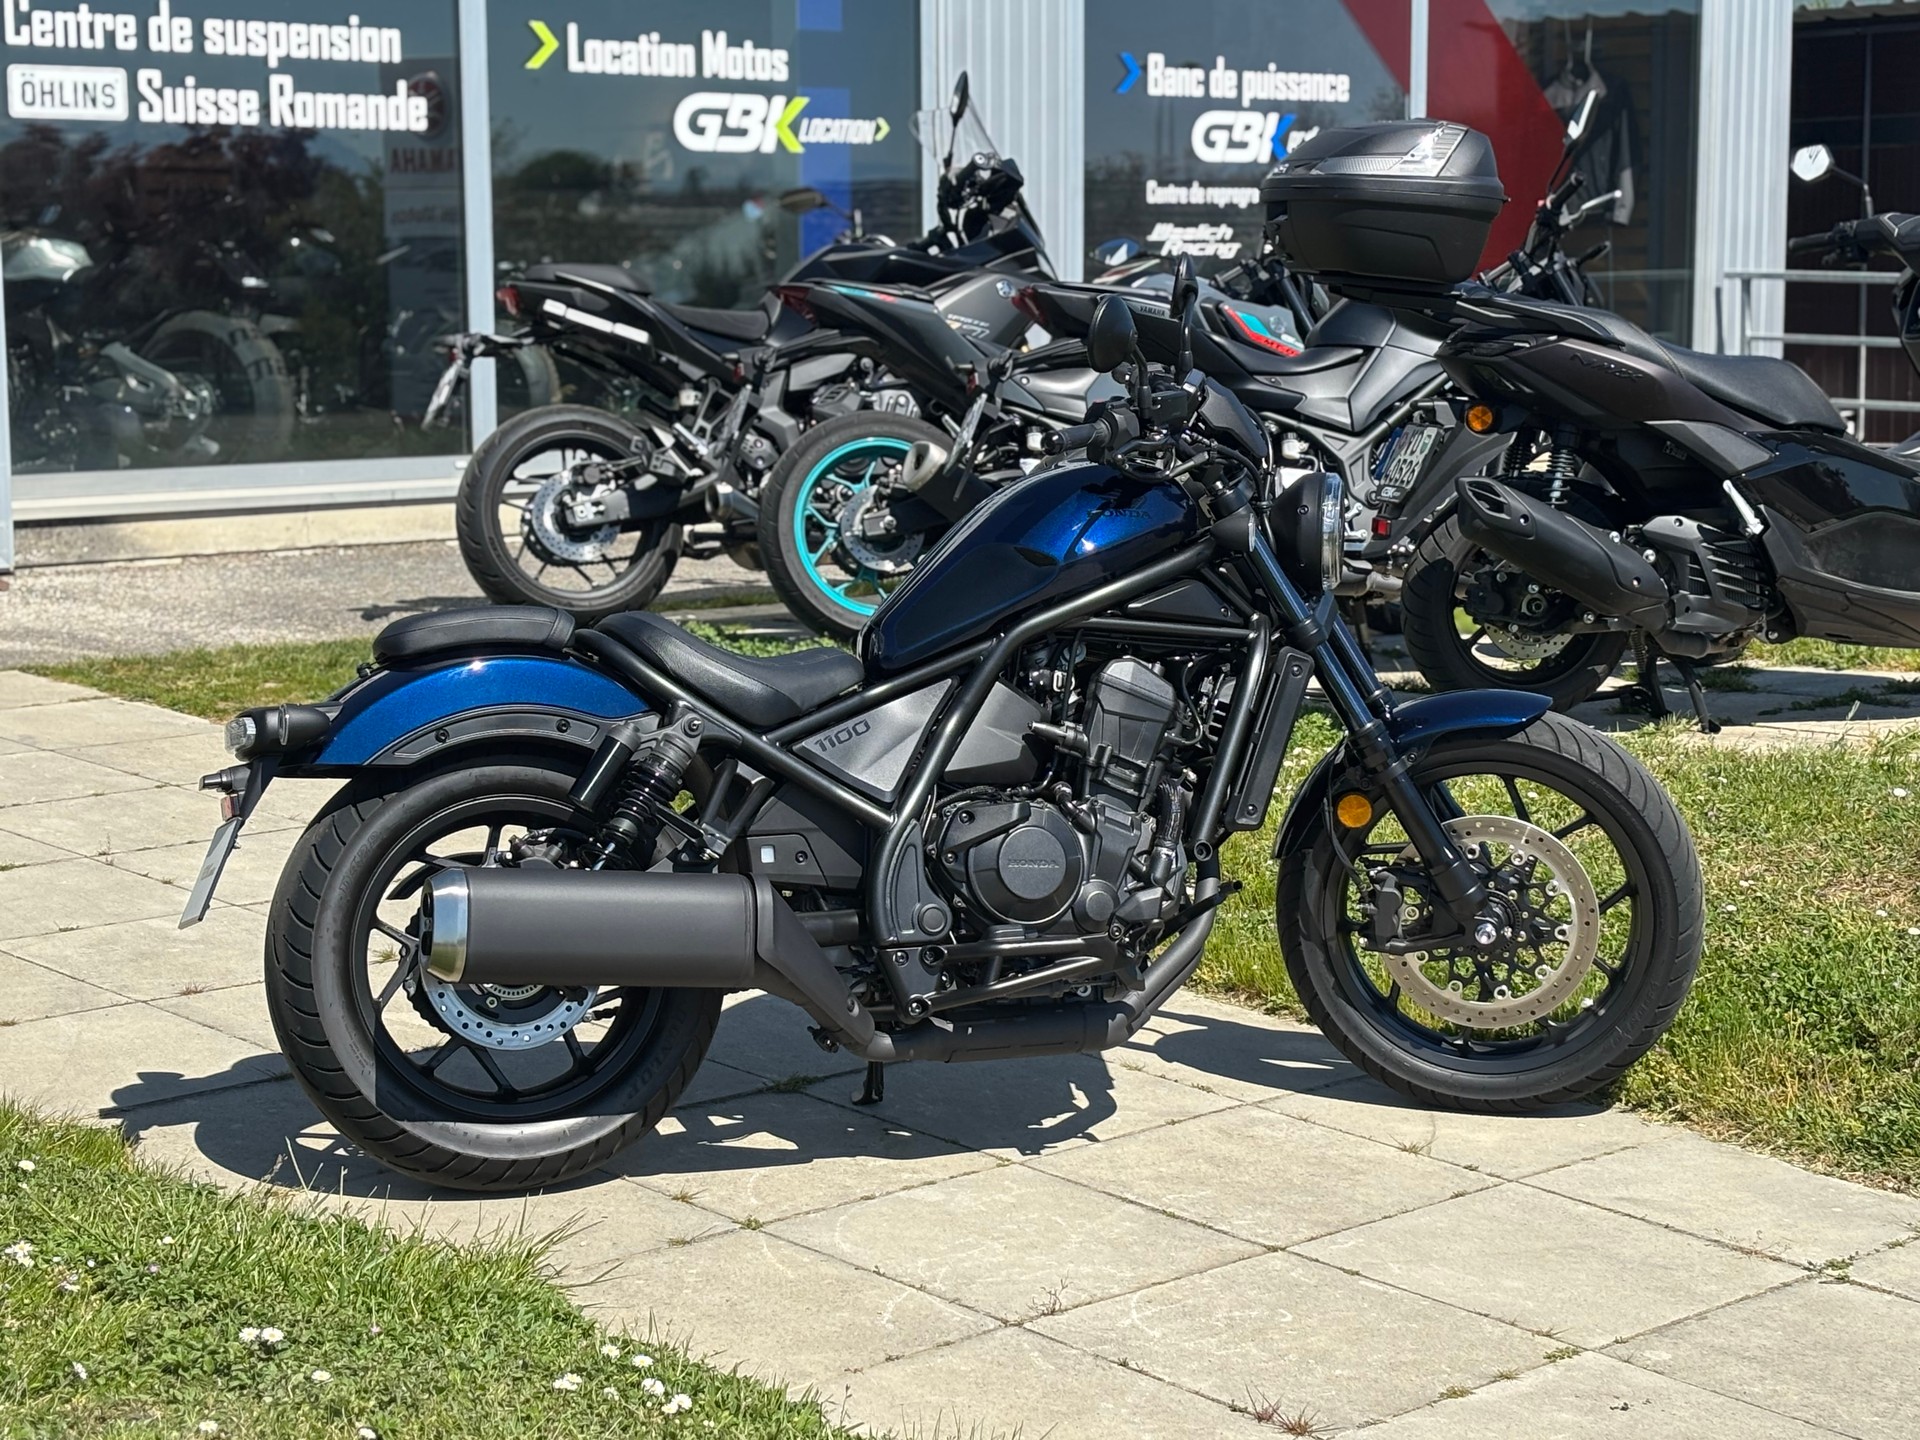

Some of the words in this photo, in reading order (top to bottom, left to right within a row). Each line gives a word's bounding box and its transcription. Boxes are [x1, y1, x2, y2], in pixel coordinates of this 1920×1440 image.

[3, 0, 138, 51] Centre
[147, 0, 194, 53] de
[203, 14, 402, 68] suspension
[566, 21, 696, 78] Location
[702, 29, 790, 82] Motos
[21, 72, 117, 109] ÖHLINS
[137, 68, 261, 126] Suisse
[269, 74, 428, 132] Romande
[1147, 52, 1205, 98] Banc
[1209, 55, 1238, 99] de
[1242, 62, 1350, 108] puissance
[673, 91, 810, 154] GBK
[798, 117, 876, 145] LOCATION
[1191, 110, 1297, 164] GBK
[1146, 179, 1188, 205] Centre
[1189, 180, 1205, 205] de
[1160, 239, 1242, 259] Racing
[814, 719, 871, 752] 1100
[1008, 858, 1060, 869] HONDA
